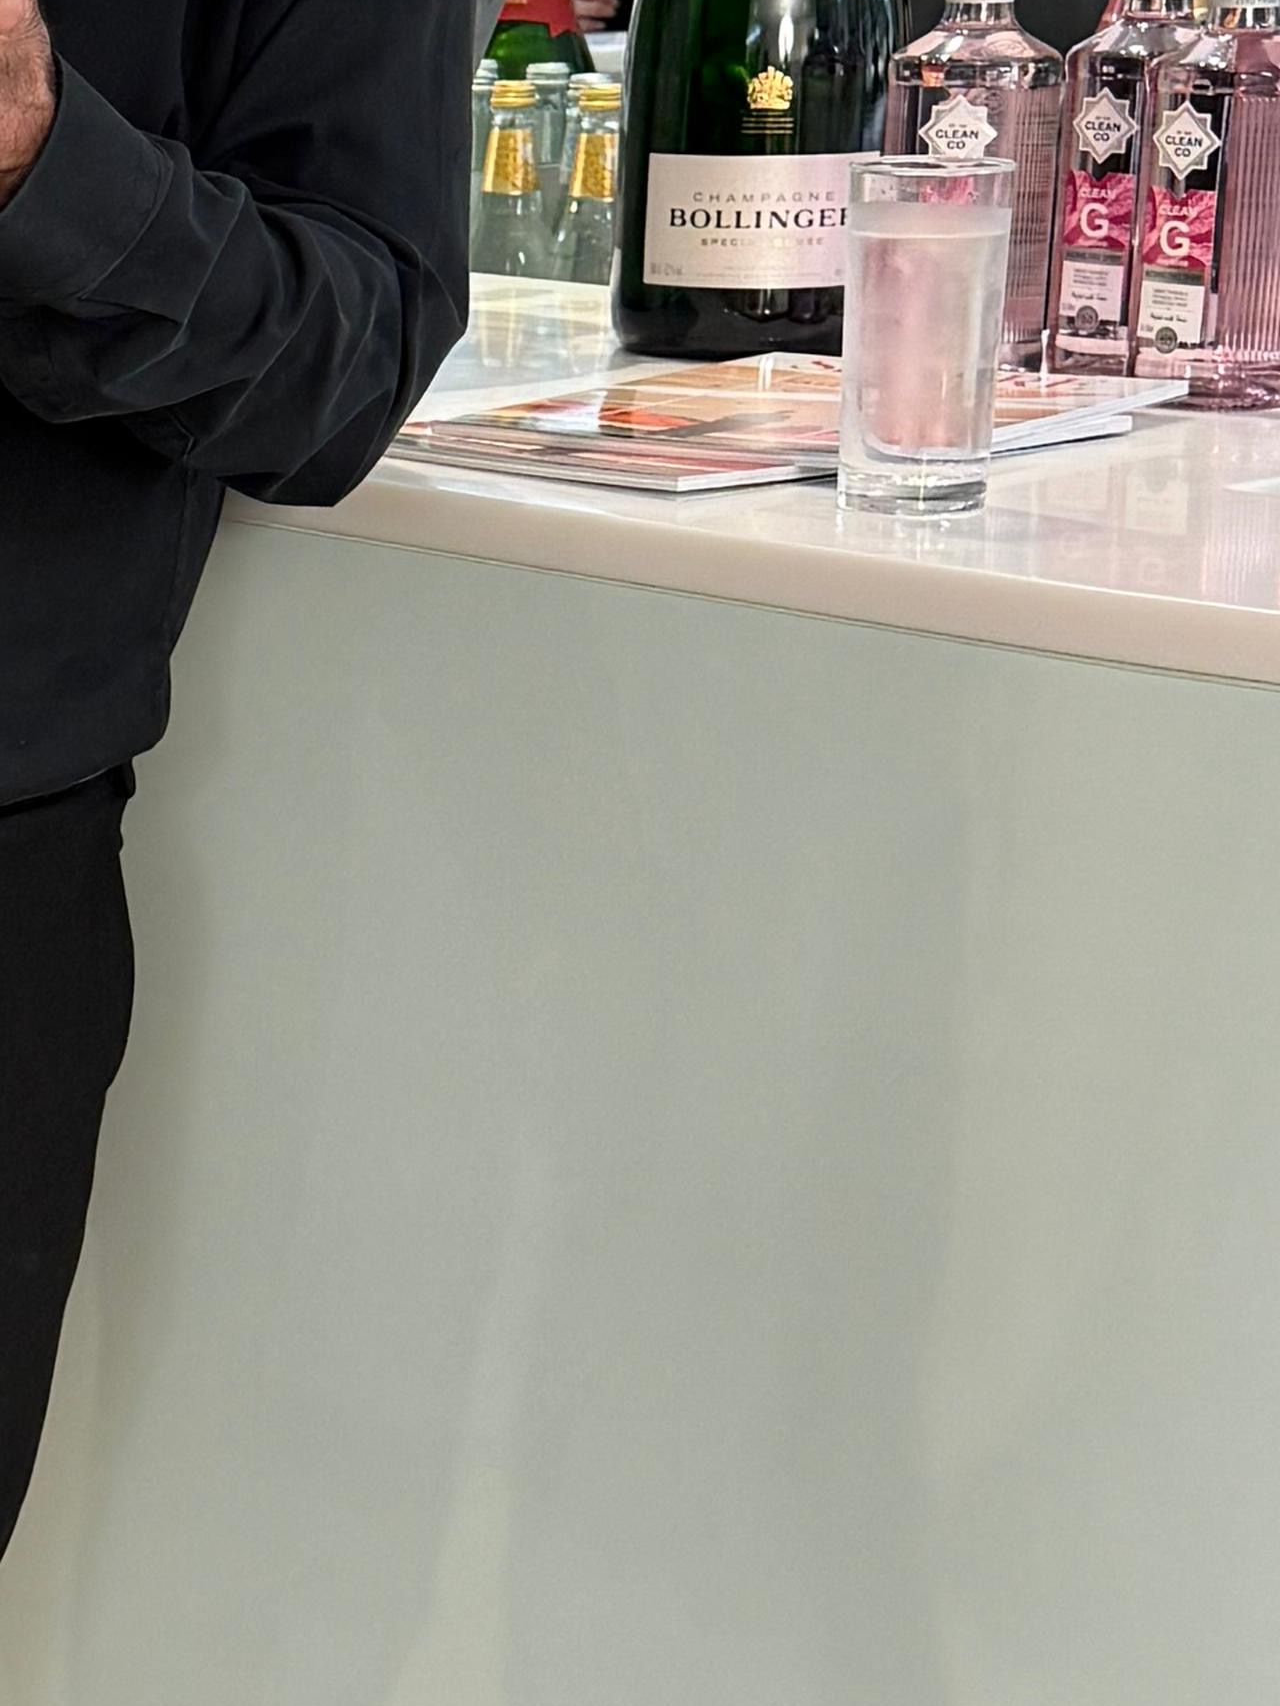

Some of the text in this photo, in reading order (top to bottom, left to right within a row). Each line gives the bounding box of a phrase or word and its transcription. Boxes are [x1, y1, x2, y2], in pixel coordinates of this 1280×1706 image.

[1084, 121, 1121, 133] CLEAN
[935, 129, 979, 140] CLEAN
[1093, 132, 1110, 142] CO
[947, 140, 966, 150] CO
[1165, 135, 1203, 147] CLEAN
[1174, 147, 1191, 158] CO
[693, 191, 835, 204] CHAMPAGNE
[1080, 202, 1109, 239] G
[1160, 220, 1190, 258] G
